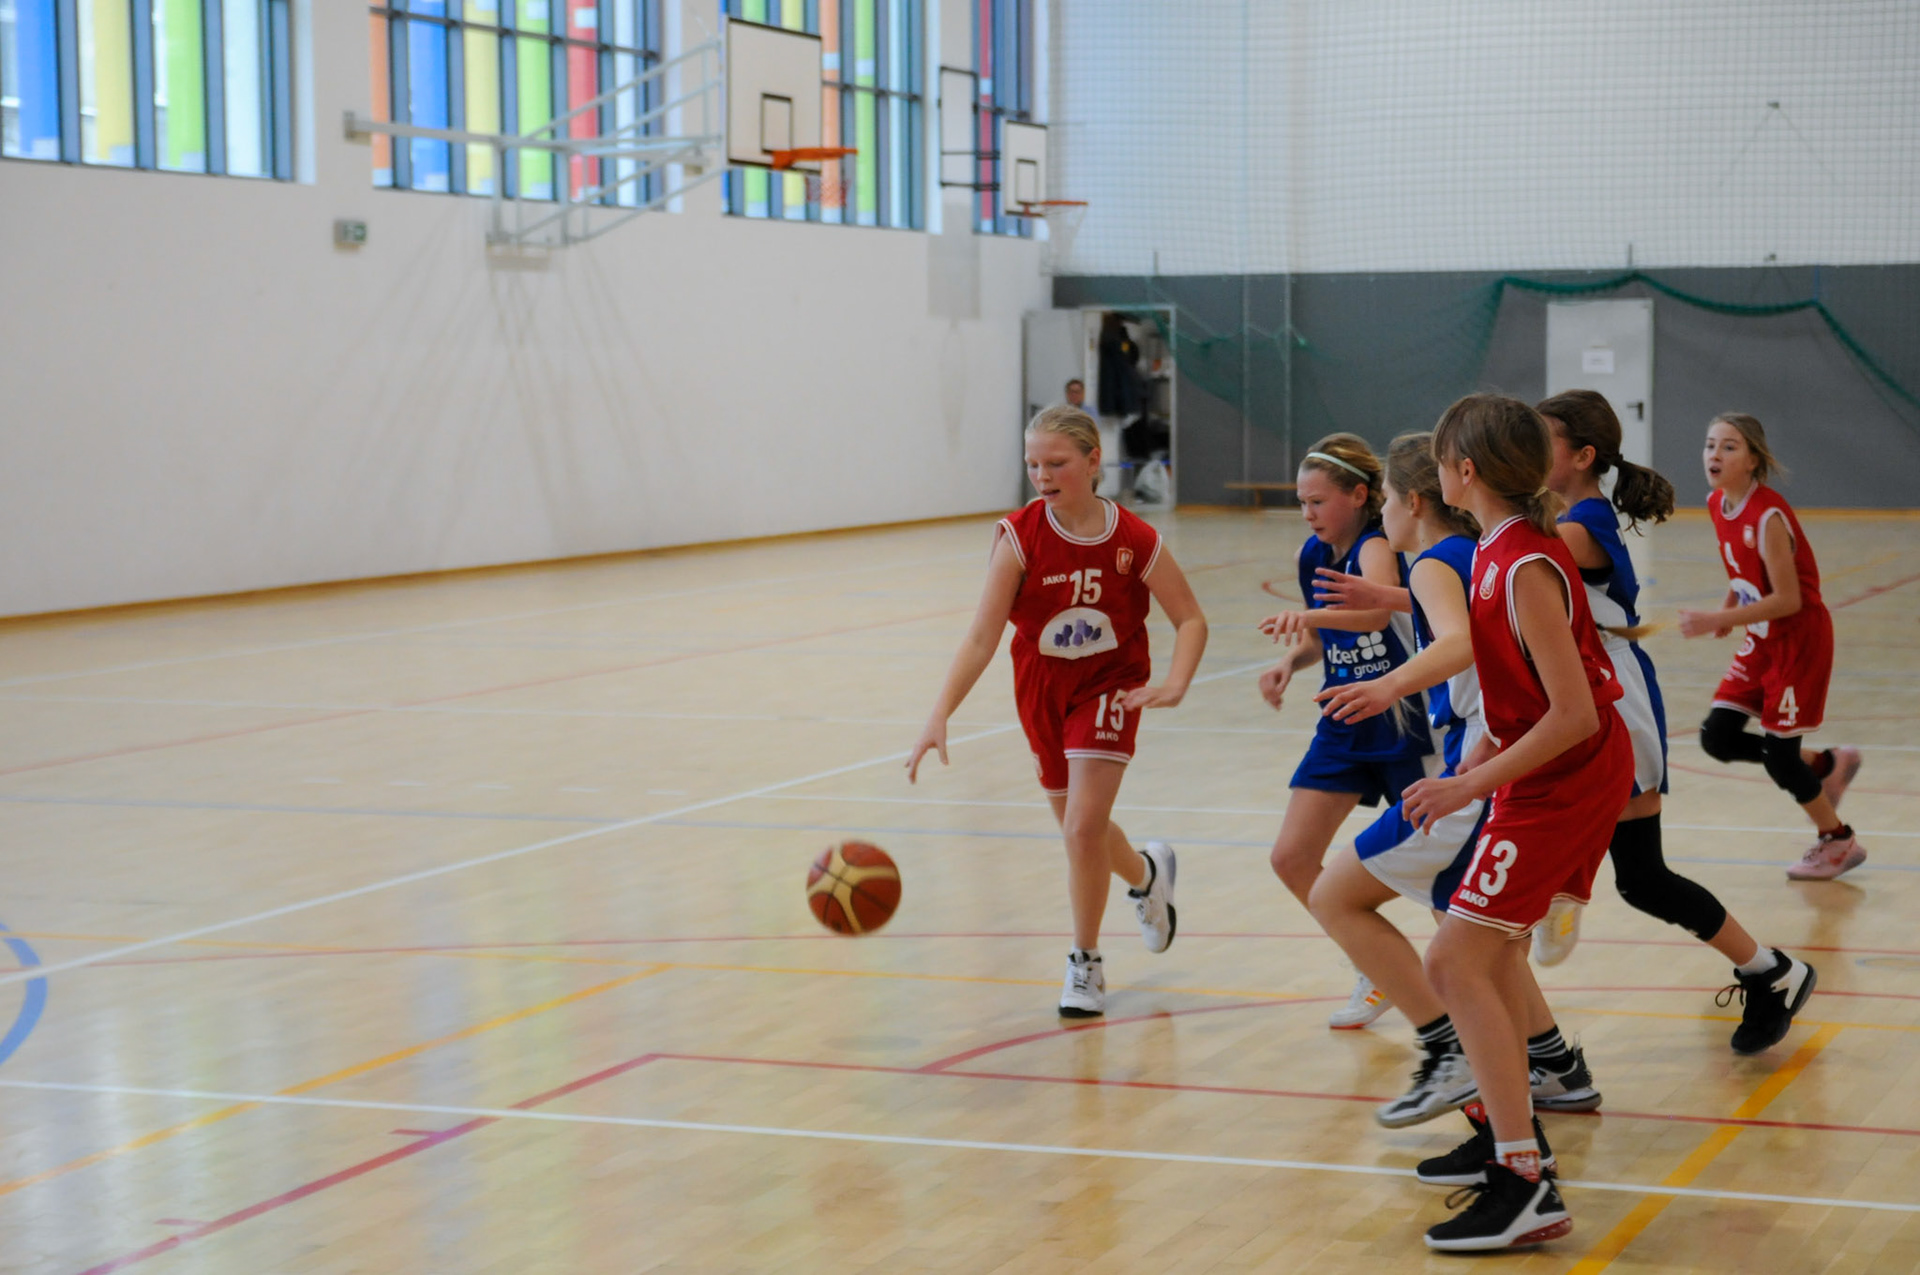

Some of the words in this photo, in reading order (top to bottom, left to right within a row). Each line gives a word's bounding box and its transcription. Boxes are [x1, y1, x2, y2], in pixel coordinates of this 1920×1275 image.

[1042, 574, 1067, 586] JAKO
[1069, 568, 1102, 607] 15
[1353, 660, 1390, 679] group
[1094, 689, 1125, 731] 15
[1778, 686, 1800, 721] 4
[1094, 731, 1119, 742] JAKO
[1462, 834, 1518, 896] 13
[1458, 889, 1489, 908] JAKO
